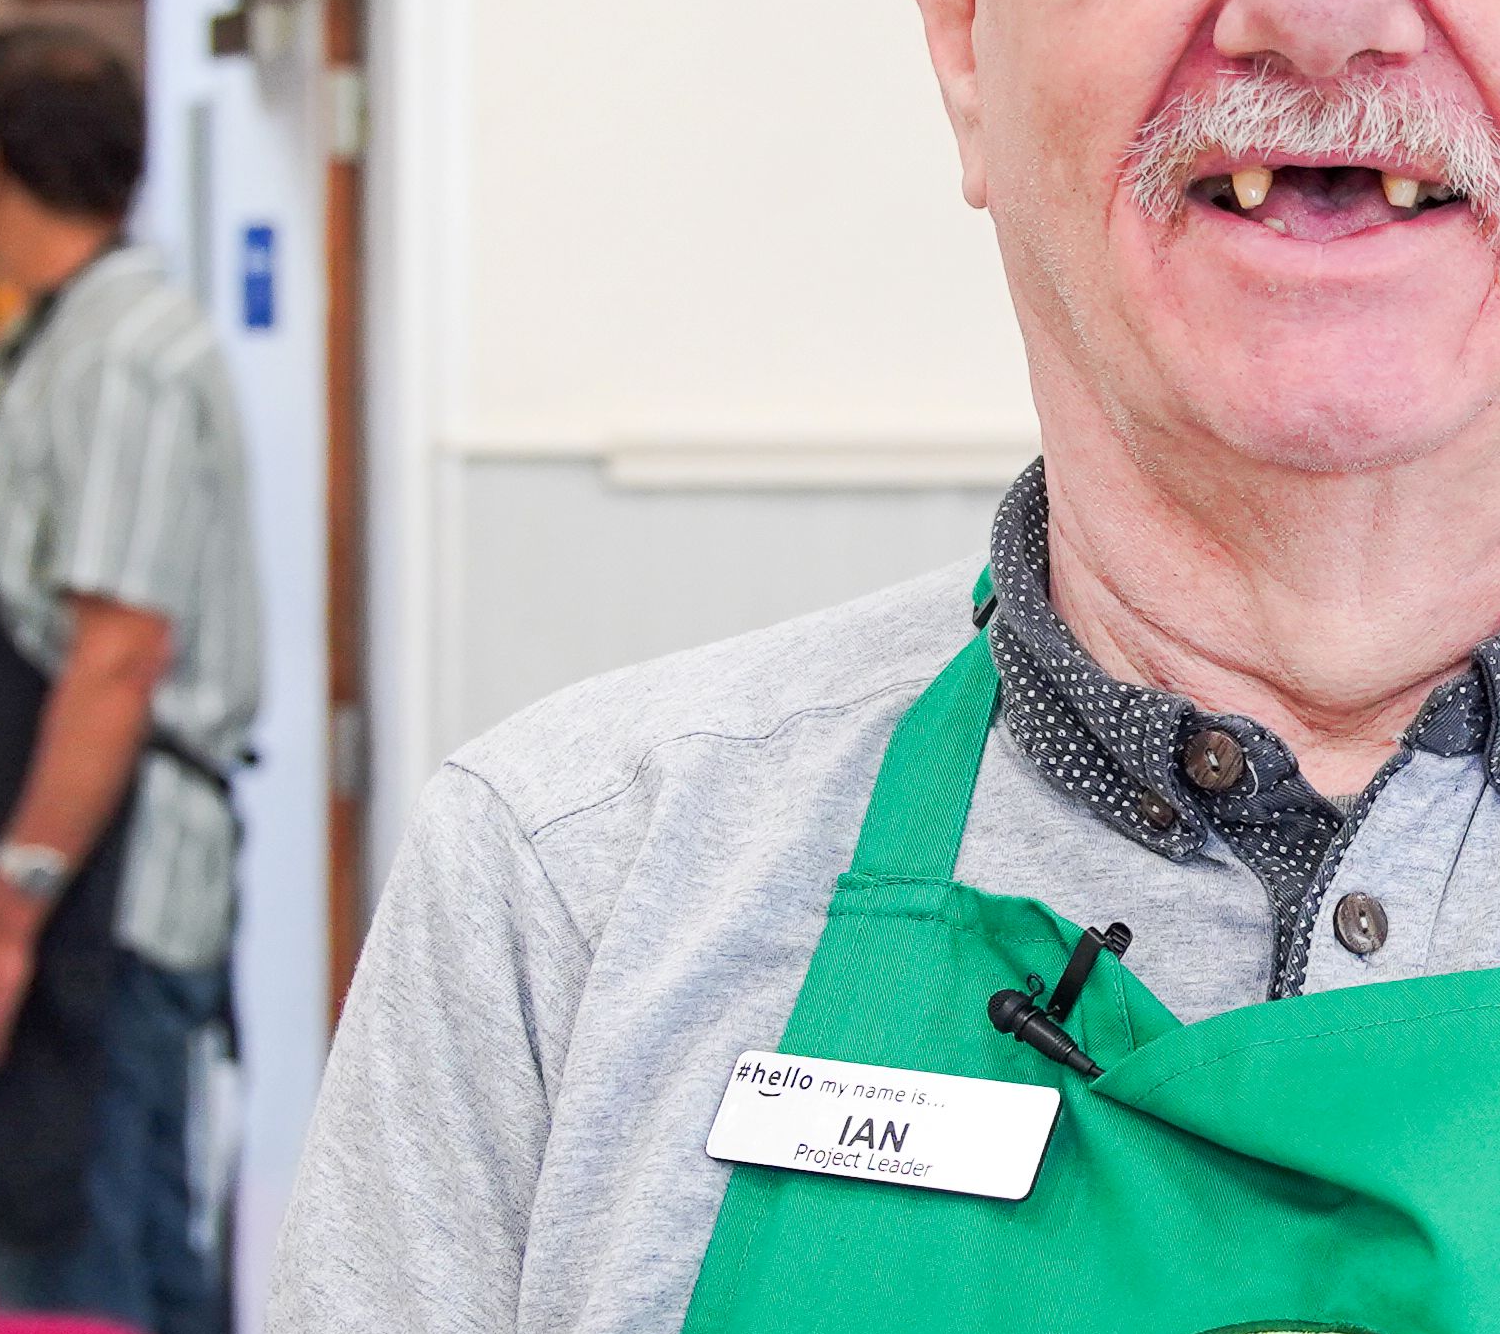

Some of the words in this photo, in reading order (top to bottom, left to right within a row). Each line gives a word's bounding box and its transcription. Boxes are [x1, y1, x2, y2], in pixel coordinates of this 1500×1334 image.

[735, 1061, 813, 1092] #hello
[819, 1078, 848, 1098] my
[853, 1082, 905, 1103] name
[911, 1088, 946, 1109] is...
[838, 1115, 910, 1153] IAN
[794, 1143, 862, 1170] Project
[867, 1153, 933, 1178] Leader
